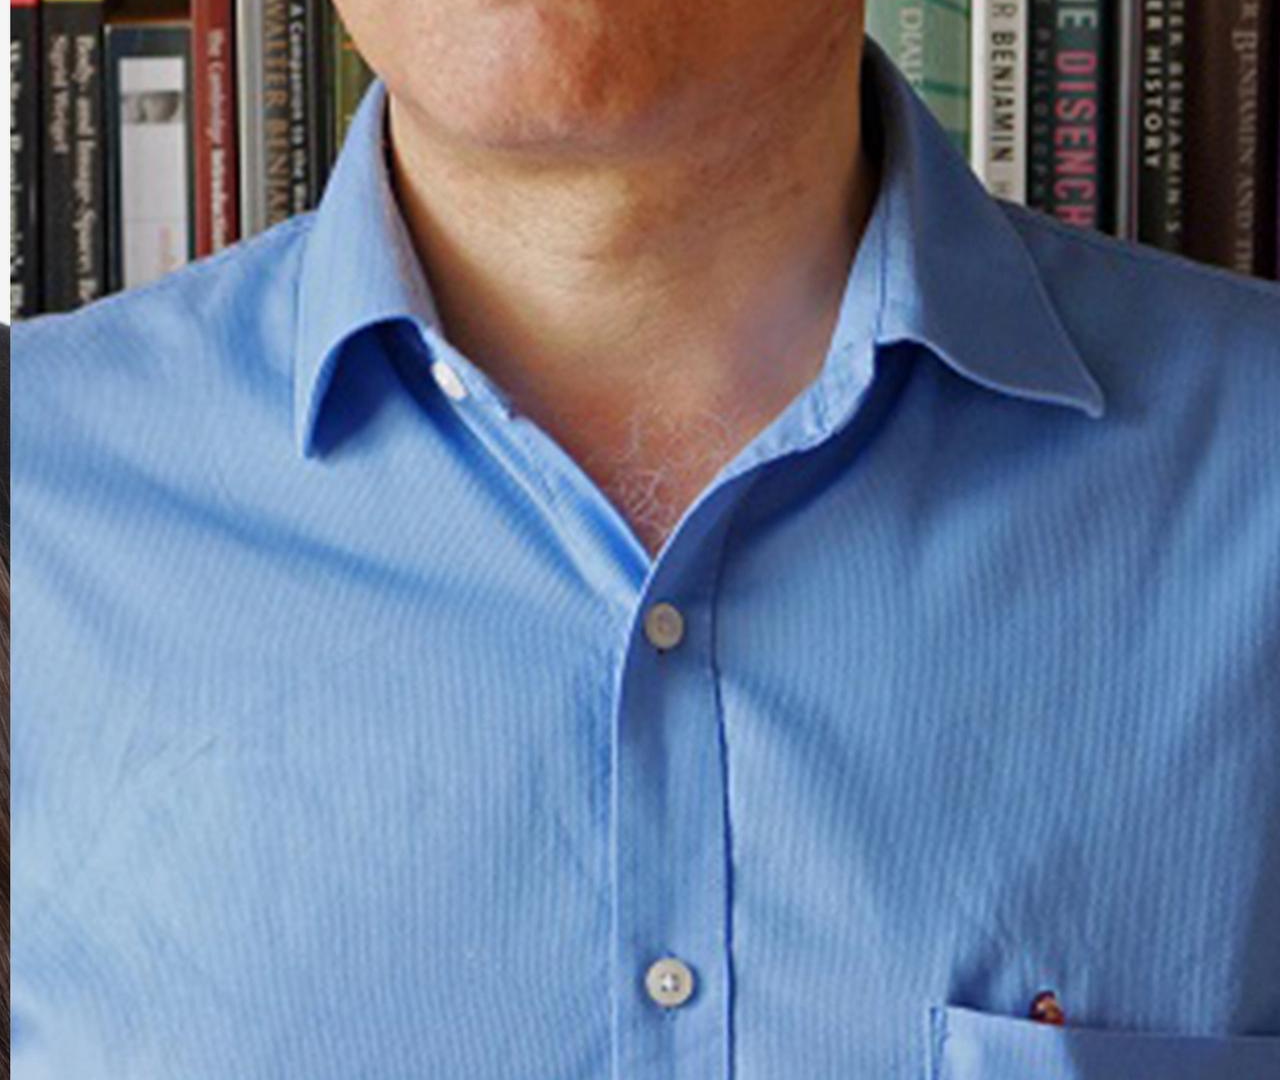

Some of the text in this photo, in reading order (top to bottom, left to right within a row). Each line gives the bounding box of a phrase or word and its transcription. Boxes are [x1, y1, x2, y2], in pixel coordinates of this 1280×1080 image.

[990, 31, 1017, 163] BENJAMIN
[1144, 45, 1164, 168] HISTORY
[1166, 62, 1184, 233] BENJAMIN'S
